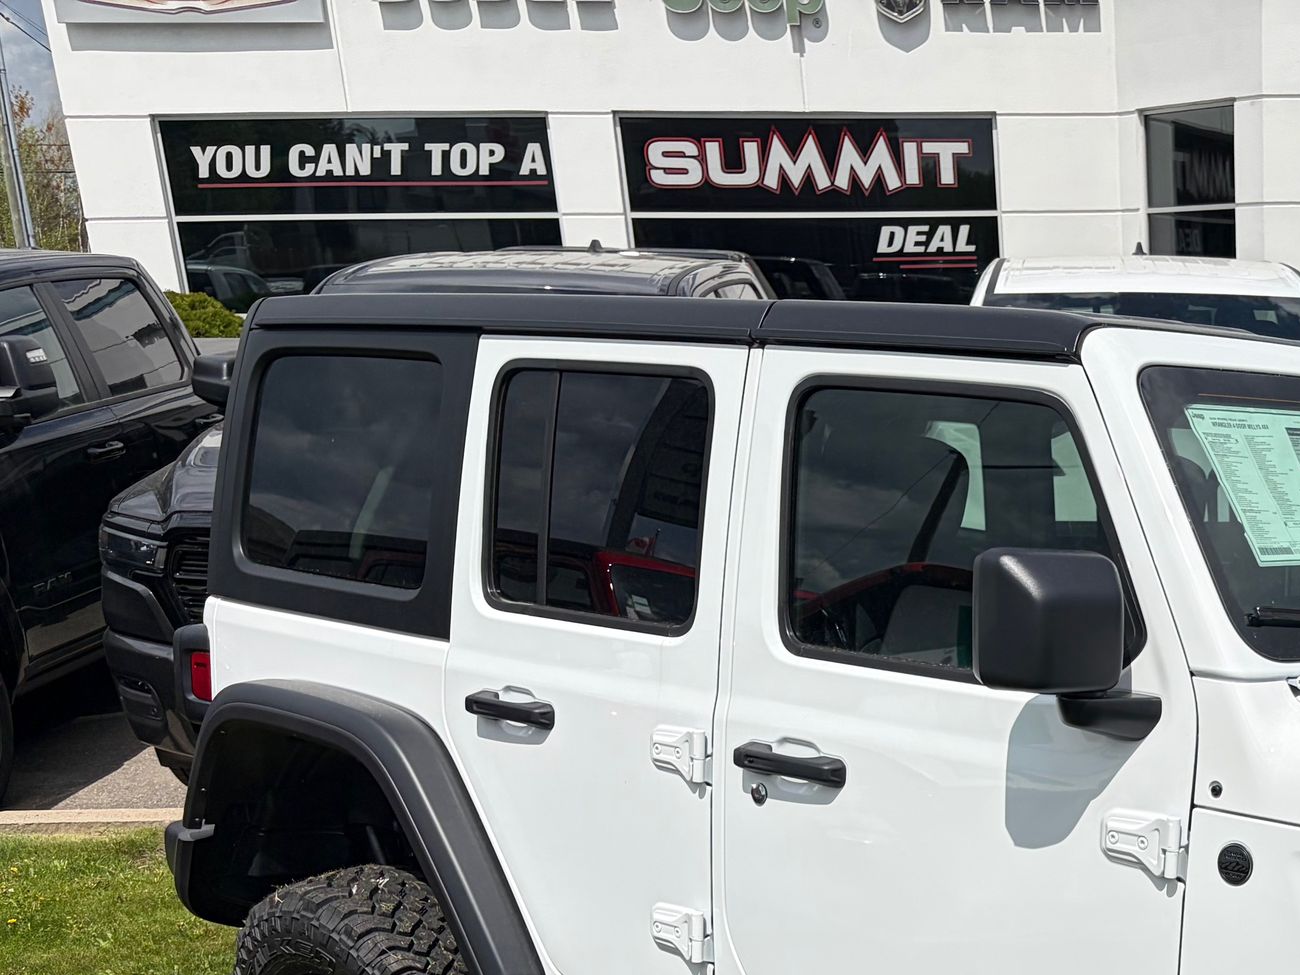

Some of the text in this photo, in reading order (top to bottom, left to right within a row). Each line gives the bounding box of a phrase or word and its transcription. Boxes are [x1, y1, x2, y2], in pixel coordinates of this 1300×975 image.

[190, 142, 547, 179] YOU CAN'T TOP A
[645, 126, 972, 196] SUMMIT
[877, 225, 976, 253] DEAL
